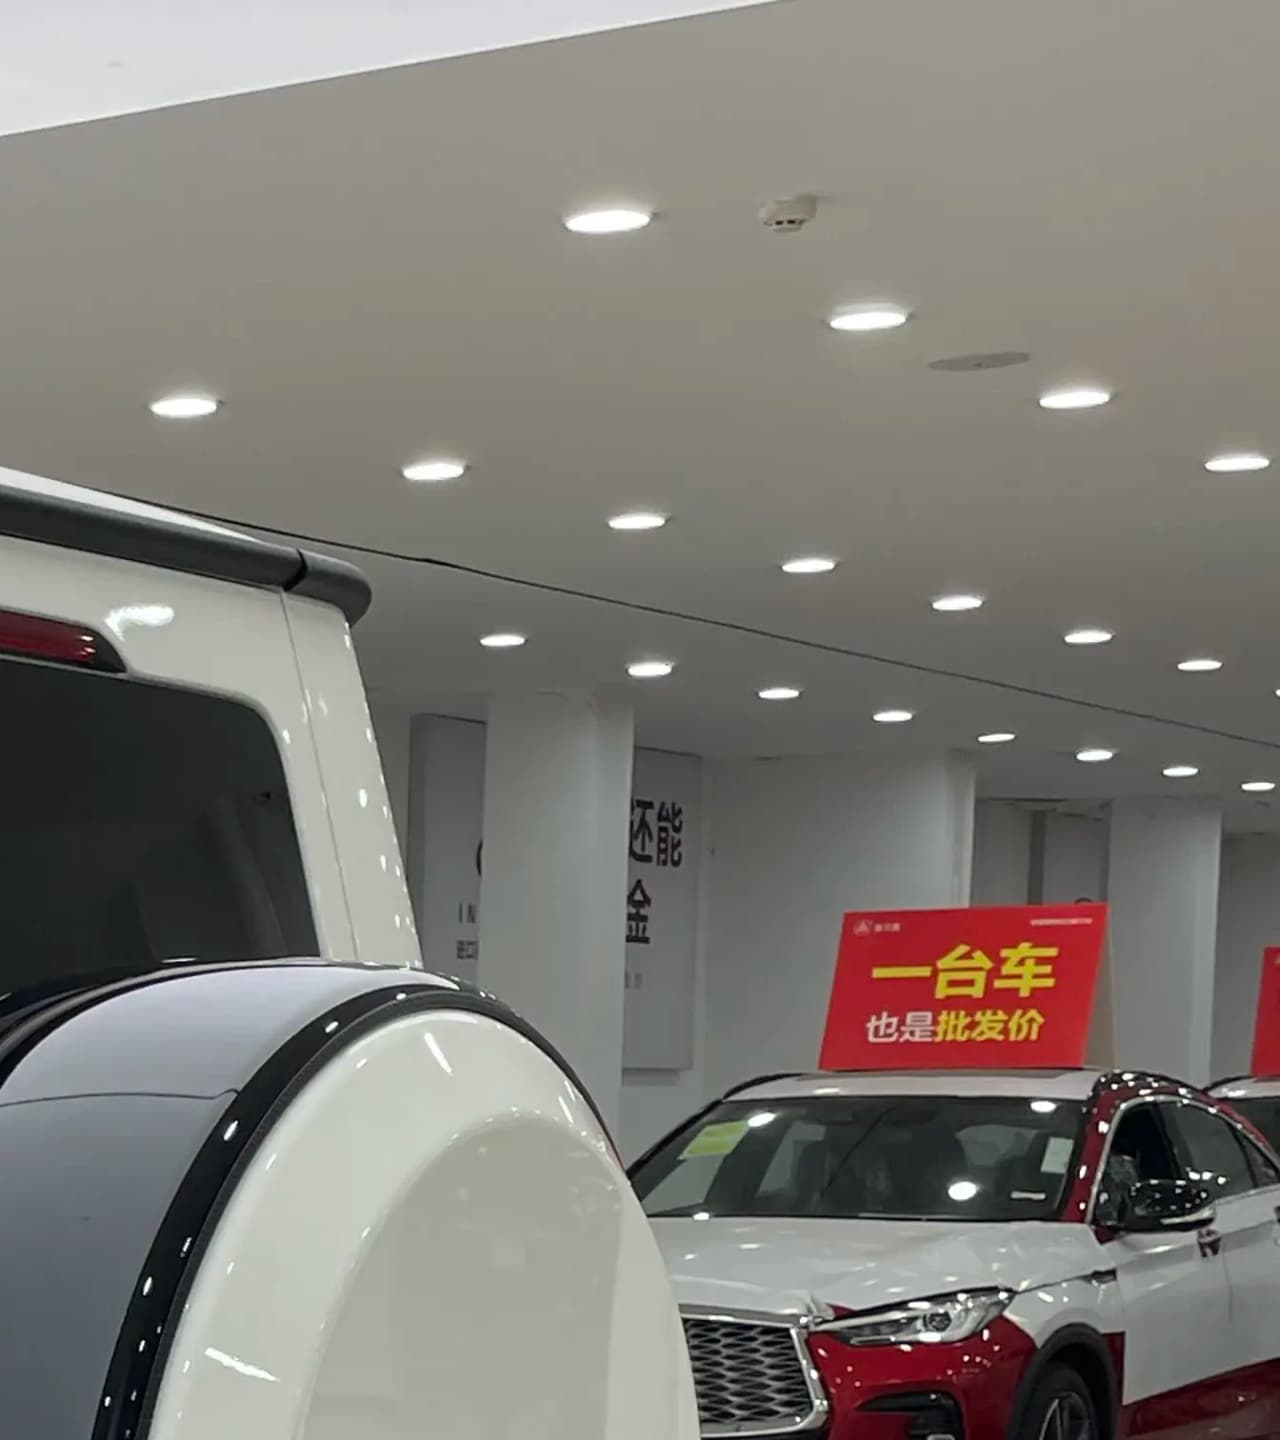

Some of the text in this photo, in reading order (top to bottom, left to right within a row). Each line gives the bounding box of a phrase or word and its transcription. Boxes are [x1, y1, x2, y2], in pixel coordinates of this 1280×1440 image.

[629, 799, 683, 868] 还能
[871, 941, 1059, 999] 一台车
[866, 1008, 1045, 1043] 也是批发价
